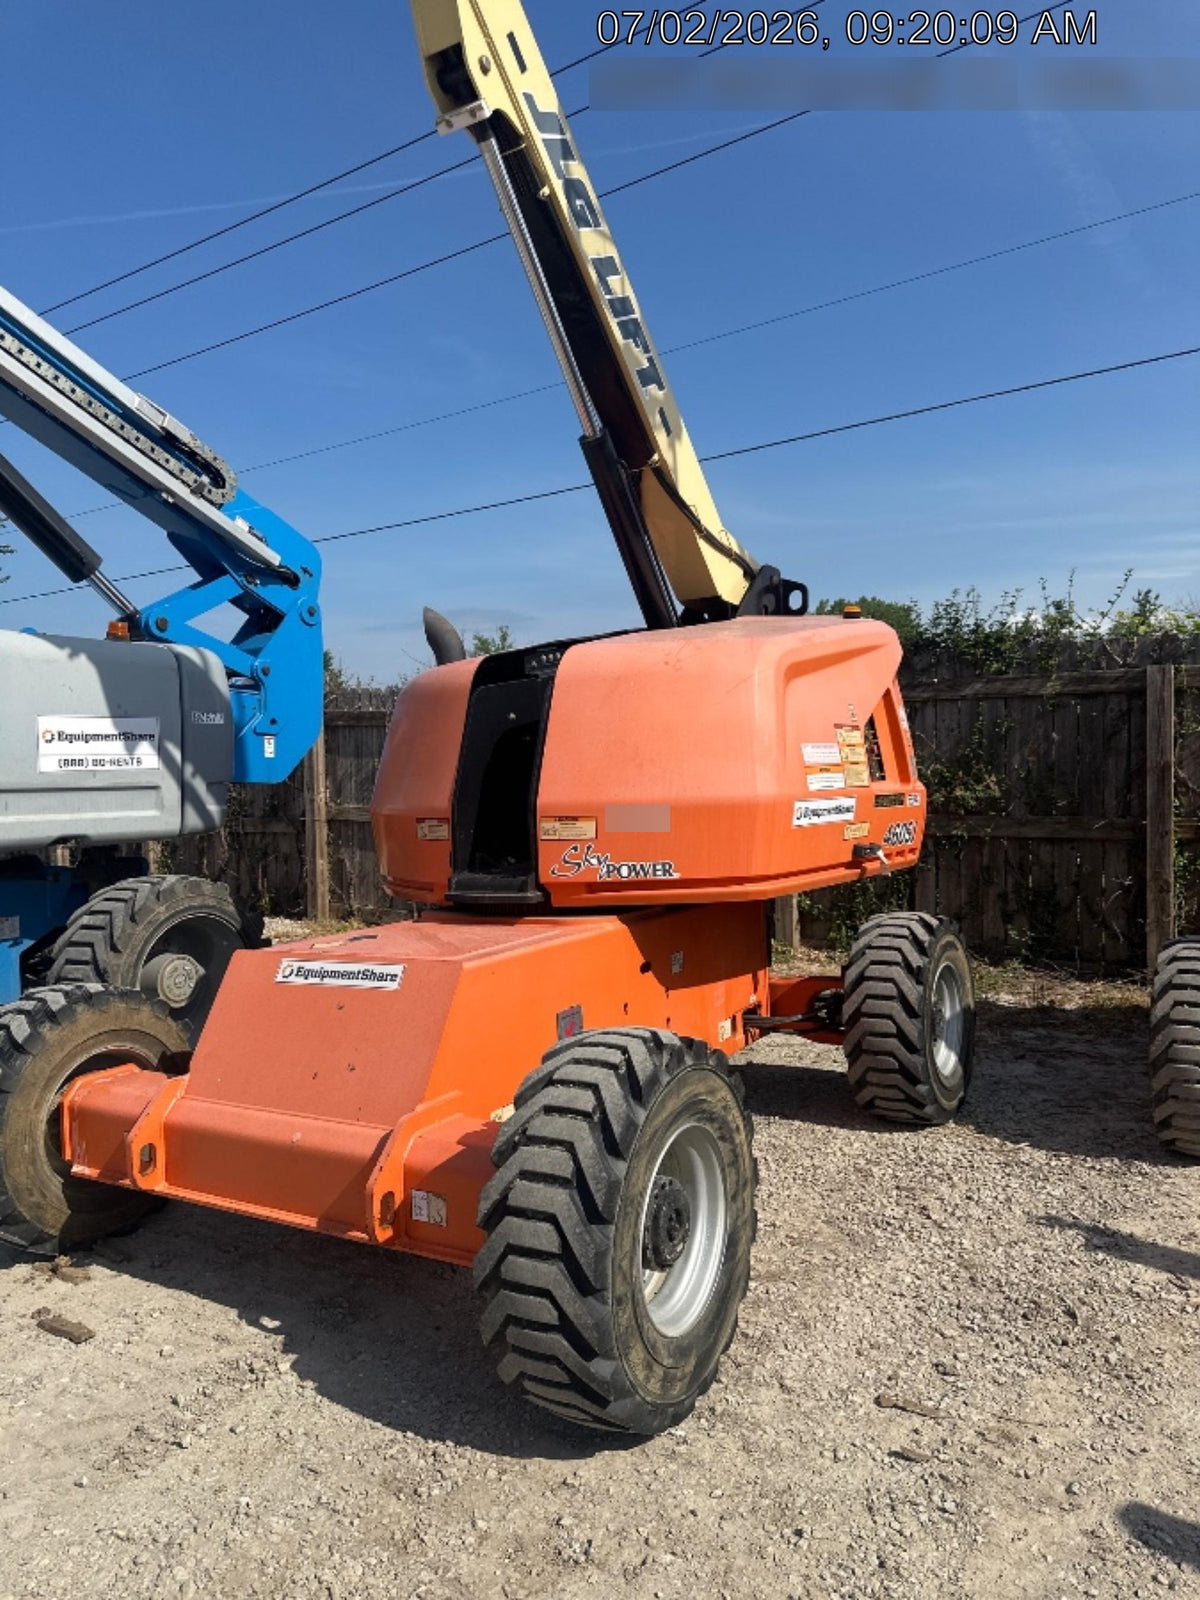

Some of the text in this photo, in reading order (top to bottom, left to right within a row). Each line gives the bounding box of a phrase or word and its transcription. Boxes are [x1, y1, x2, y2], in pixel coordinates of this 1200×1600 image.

[522, 90, 668, 399] JLG LIFT
[57, 730, 156, 745] EquipmentShare
[294, 964, 399, 983] EquipmentShare
